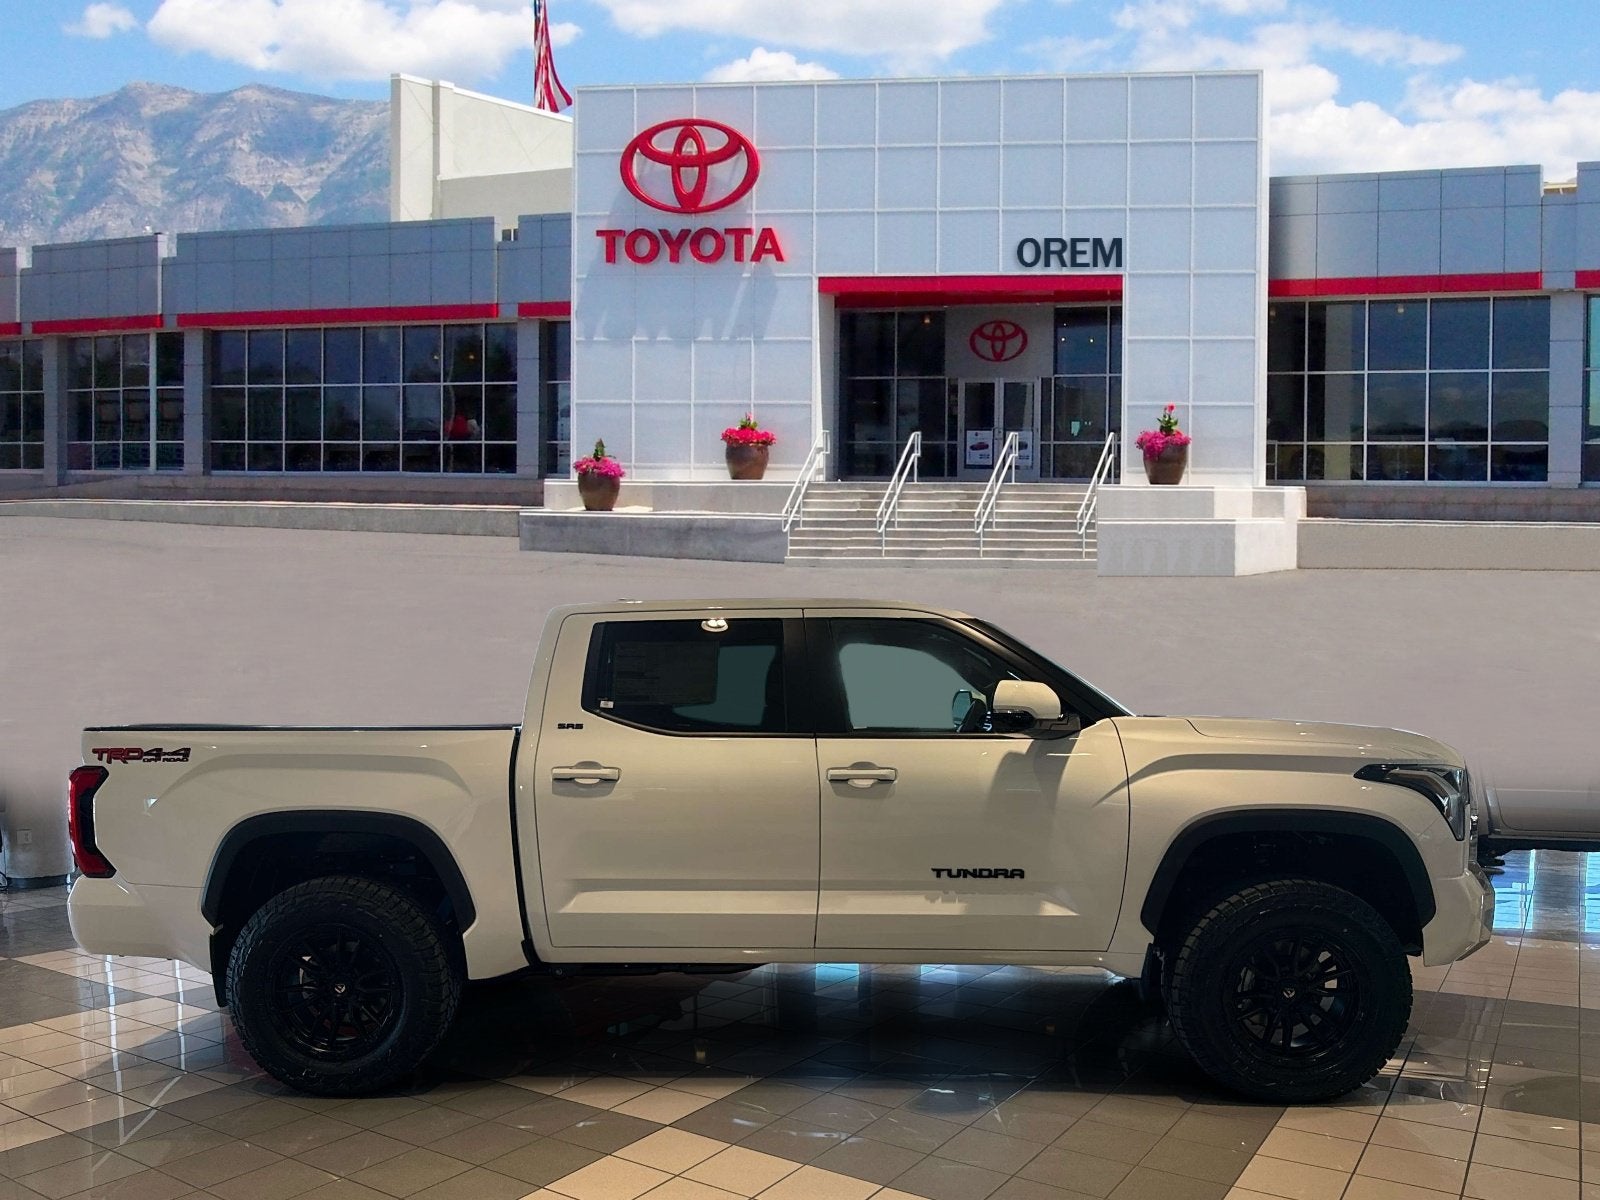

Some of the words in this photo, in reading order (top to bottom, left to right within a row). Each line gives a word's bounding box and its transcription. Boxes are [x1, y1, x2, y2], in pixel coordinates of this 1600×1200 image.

[596, 226, 784, 264] TOYOTA
[1016, 237, 1123, 268] OREM
[92, 748, 144, 764] TRD
[931, 868, 1025, 879] TUNDRA
